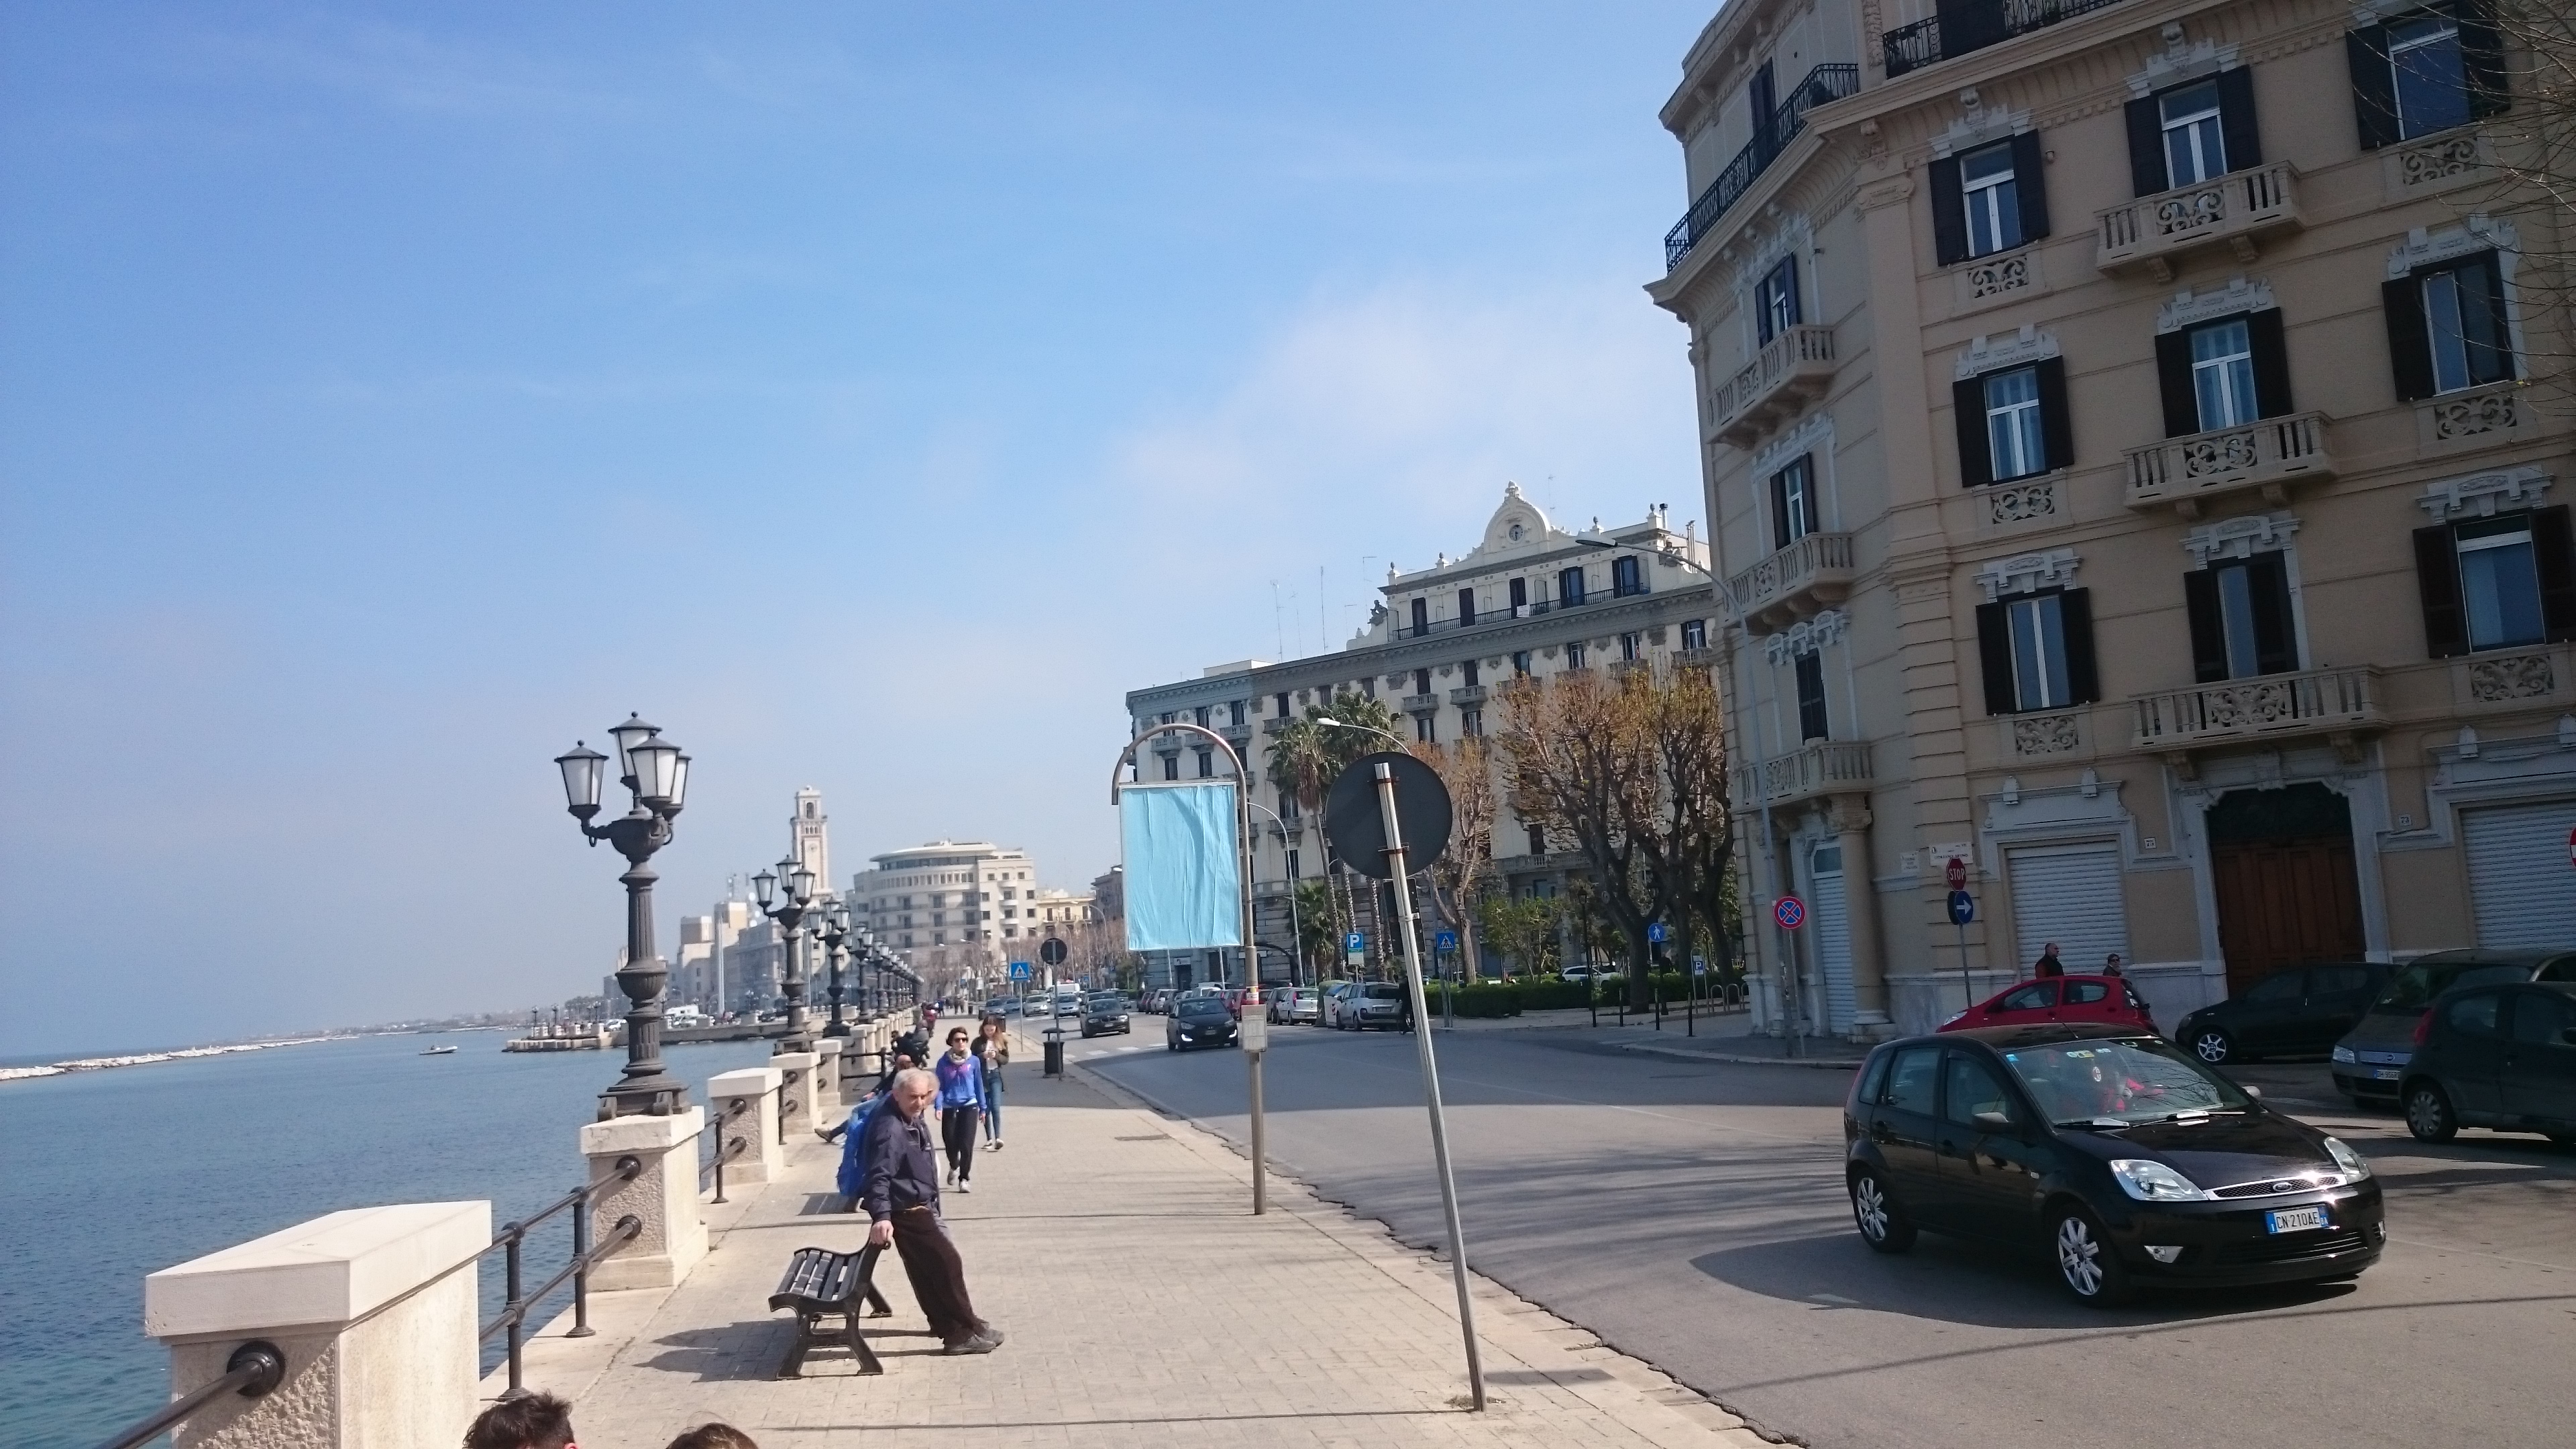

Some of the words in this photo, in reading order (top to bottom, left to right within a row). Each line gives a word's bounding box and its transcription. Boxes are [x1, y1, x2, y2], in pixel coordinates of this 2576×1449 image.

[1948, 868, 1965, 881] STOP
[1350, 934, 1360, 947] P
[1695, 961, 1702, 970] P
[2290, 1212, 2320, 1227] 210AE
